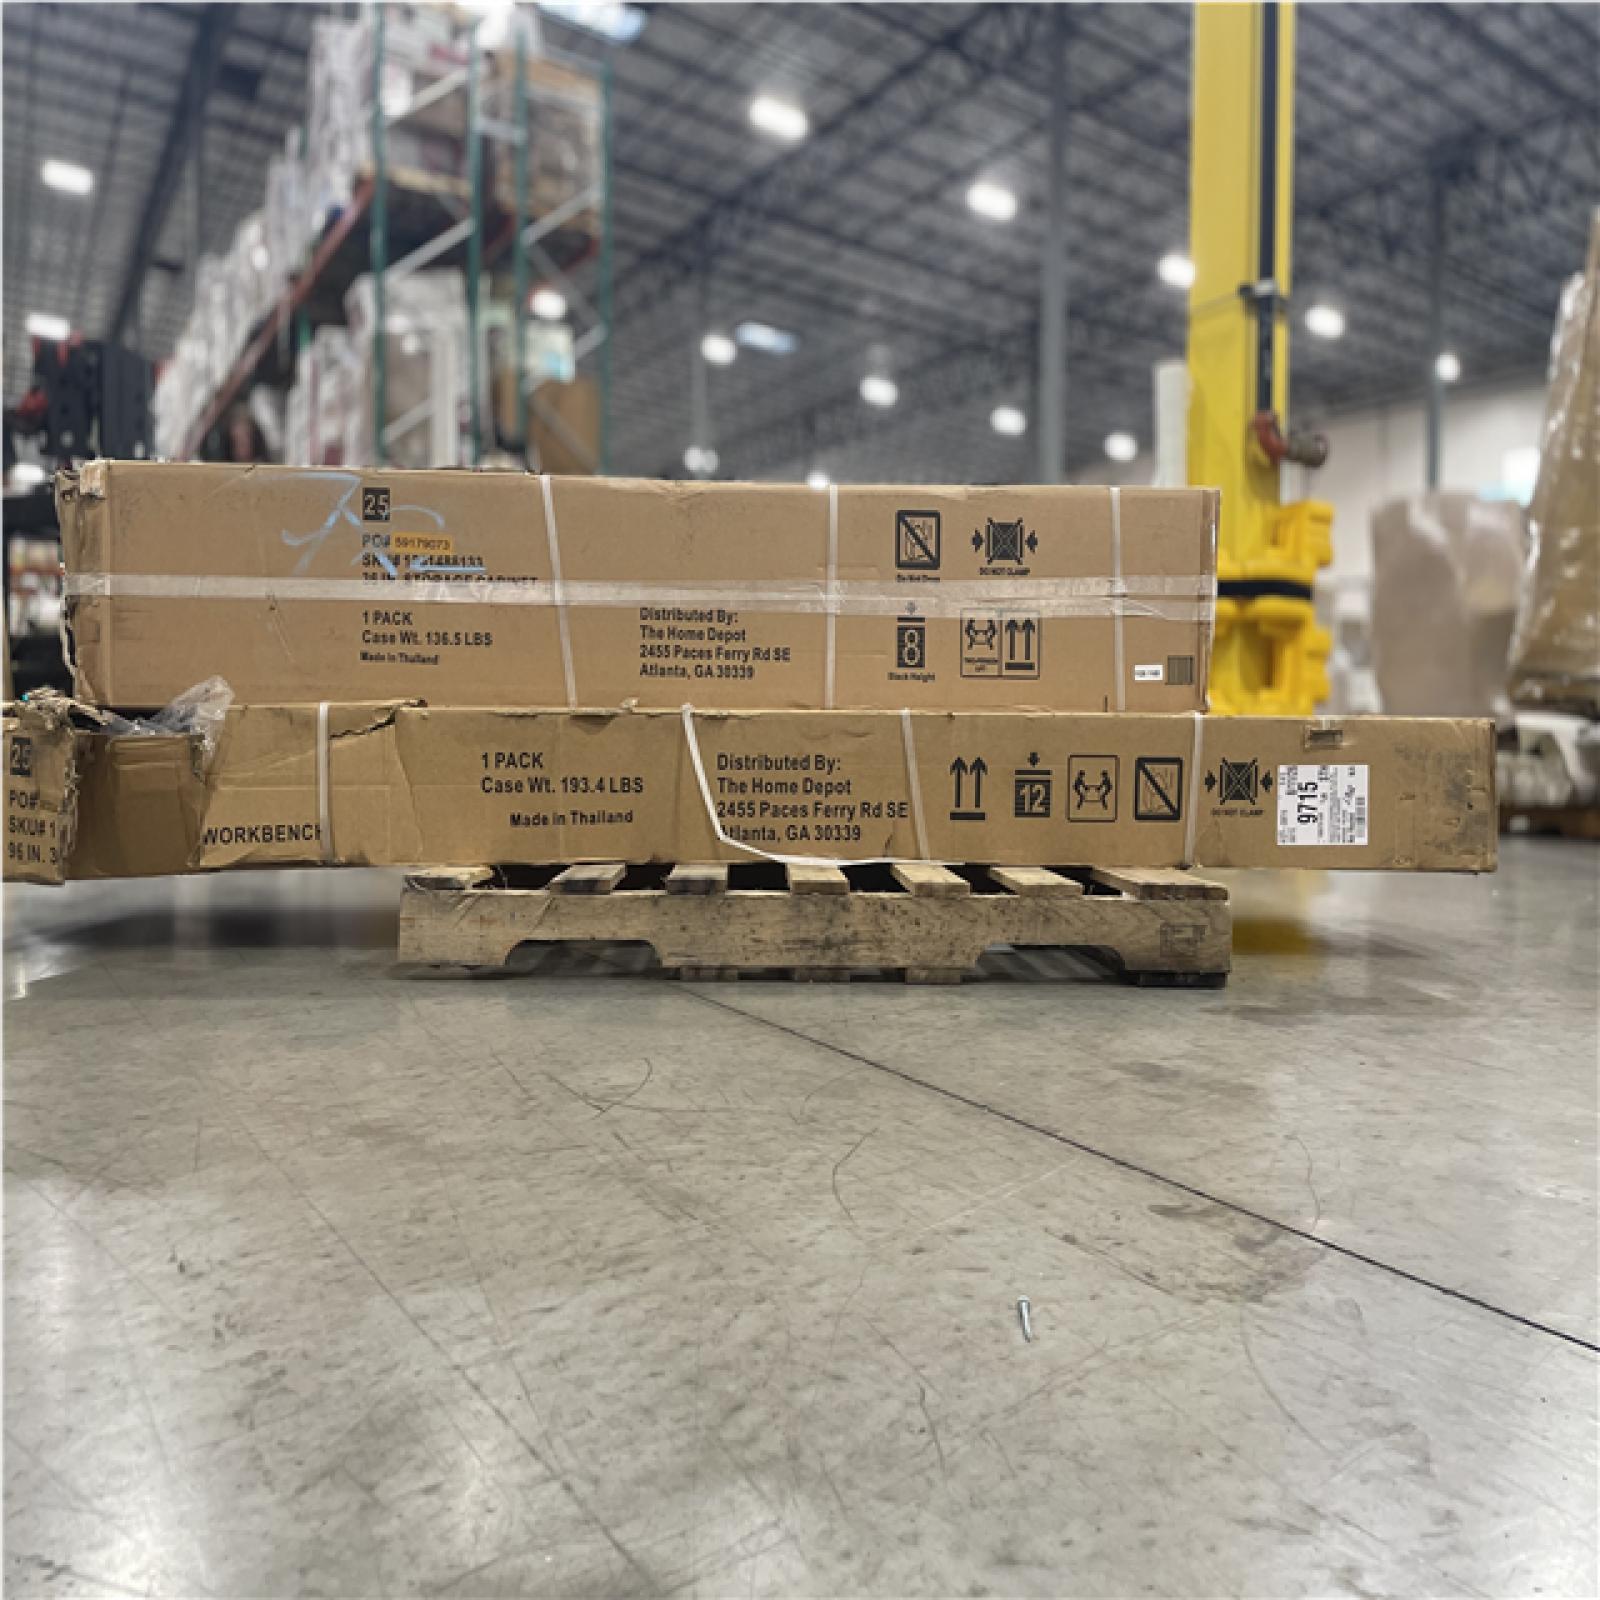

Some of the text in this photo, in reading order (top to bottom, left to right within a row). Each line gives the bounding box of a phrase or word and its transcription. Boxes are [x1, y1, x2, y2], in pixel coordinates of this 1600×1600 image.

[364, 493, 390, 515] 25
[363, 610, 412, 625] 1 PACK
[640, 608, 738, 625] Distributed By:
[362, 630, 396, 644] Case
[426, 632, 462, 646] 136.5
[465, 632, 493, 647] LBS
[640, 625, 746, 643] The Home Depot
[640, 645, 791, 663] 2455 Paces Ferry Rd SE
[904, 630, 920, 666] 8
[399, 652, 439, 665] Thailand
[640, 664, 754, 681] Atlanta, GA 30339
[482, 753, 543, 768] 1 PACK
[717, 754, 841, 774] Distributed By:
[482, 777, 643, 793] Case Wt. 193.4 LBS
[717, 777, 851, 798] The Home Depot
[10, 789, 38, 809] PO#
[1020, 784, 1046, 813] 12
[1298, 782, 1318, 823] 9715
[510, 810, 633, 827] Made in Thailand
[717, 802, 908, 822] 2455 Paces Ferry Rd SE
[10, 815, 45, 835] SKU#
[786, 824, 810, 841] GA
[815, 824, 861, 841] 30339
